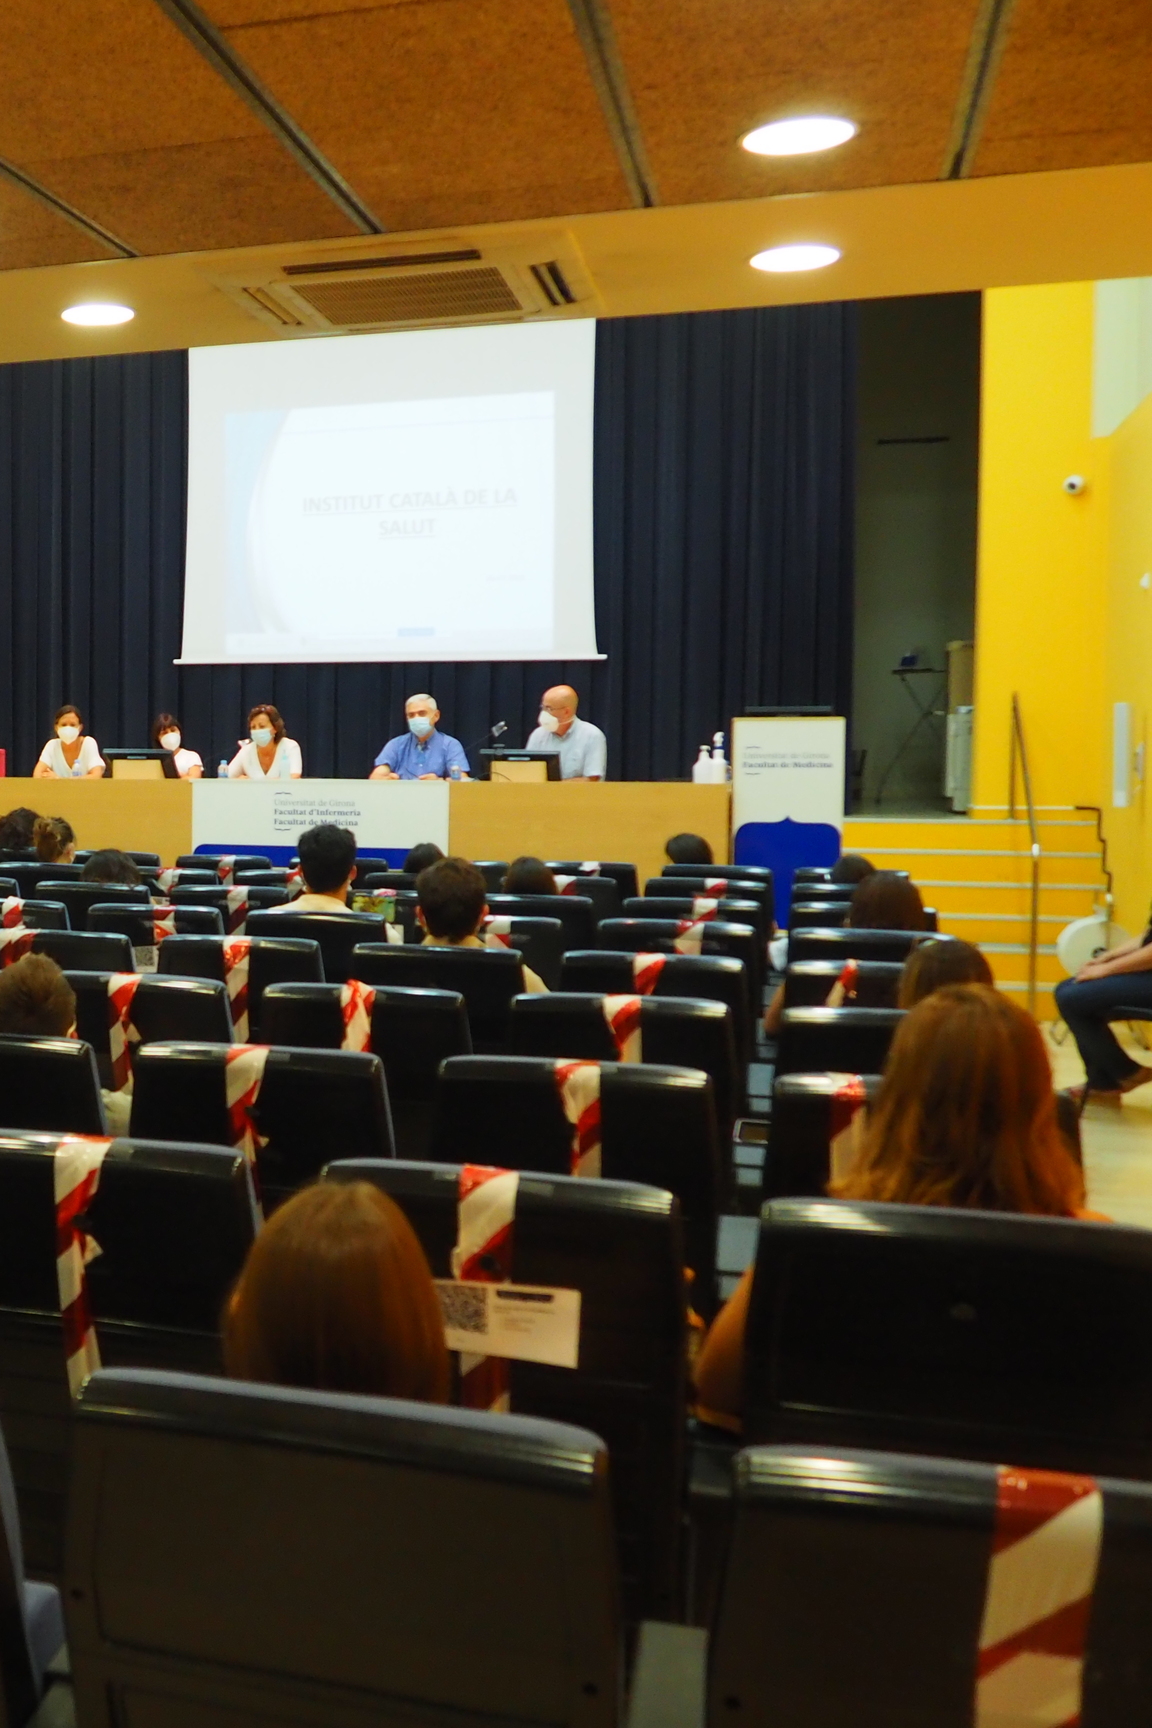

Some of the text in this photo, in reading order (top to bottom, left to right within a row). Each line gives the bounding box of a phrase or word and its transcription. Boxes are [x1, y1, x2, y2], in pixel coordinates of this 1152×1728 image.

[303, 487, 517, 513] INSTITUT CATALÀ DE LA
[378, 518, 436, 536] SALUT
[274, 799, 355, 807] Universitat de Girona
[274, 808, 307, 816] Facultat
[274, 818, 307, 826] Facultat
[308, 818, 318, 826] de
